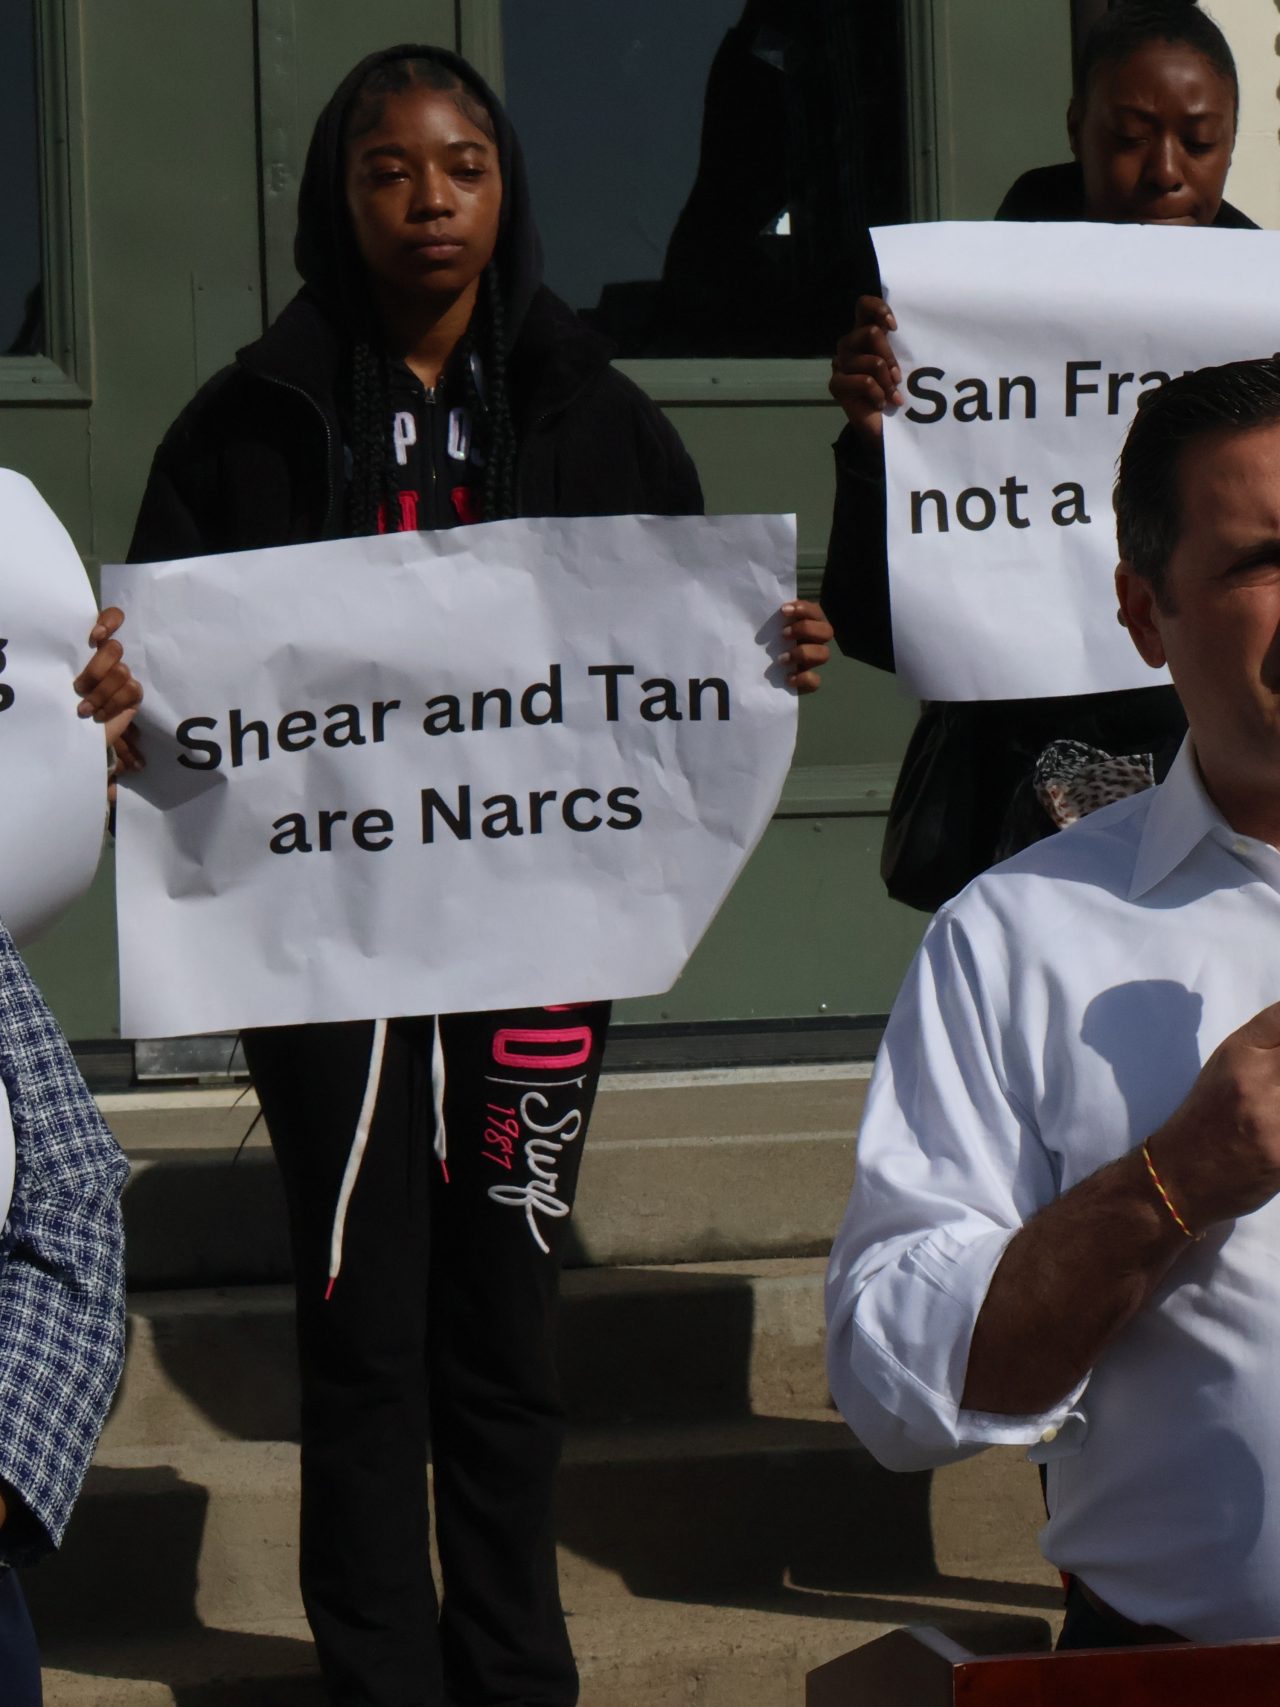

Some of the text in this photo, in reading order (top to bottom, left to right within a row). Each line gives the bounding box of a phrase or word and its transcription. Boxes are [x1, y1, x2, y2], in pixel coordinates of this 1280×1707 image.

[905, 367, 1037, 423] San
[910, 476, 1031, 534] not
[1051, 482, 1091, 526] a
[176, 663, 731, 771] Shear and Tan
[269, 784, 643, 855] are Narcs
[481, 1103, 520, 1170] 1987
